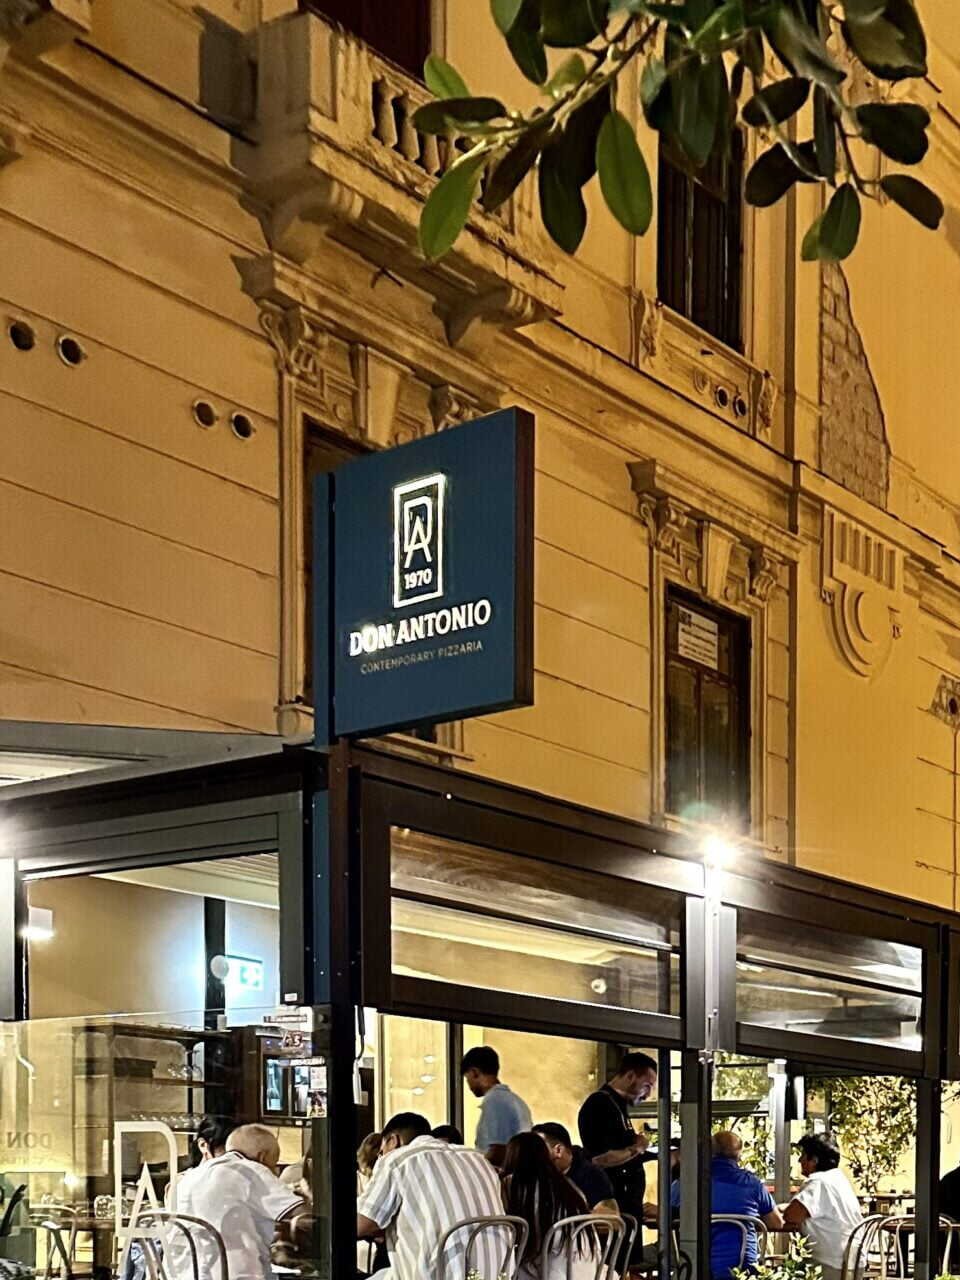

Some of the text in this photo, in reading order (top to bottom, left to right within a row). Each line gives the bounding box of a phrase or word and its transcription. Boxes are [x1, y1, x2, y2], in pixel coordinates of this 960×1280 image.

[404, 569, 432, 589] 1970
[349, 600, 491, 656] DON ANTONIO
[361, 651, 434, 674] CONTEMPORARY
